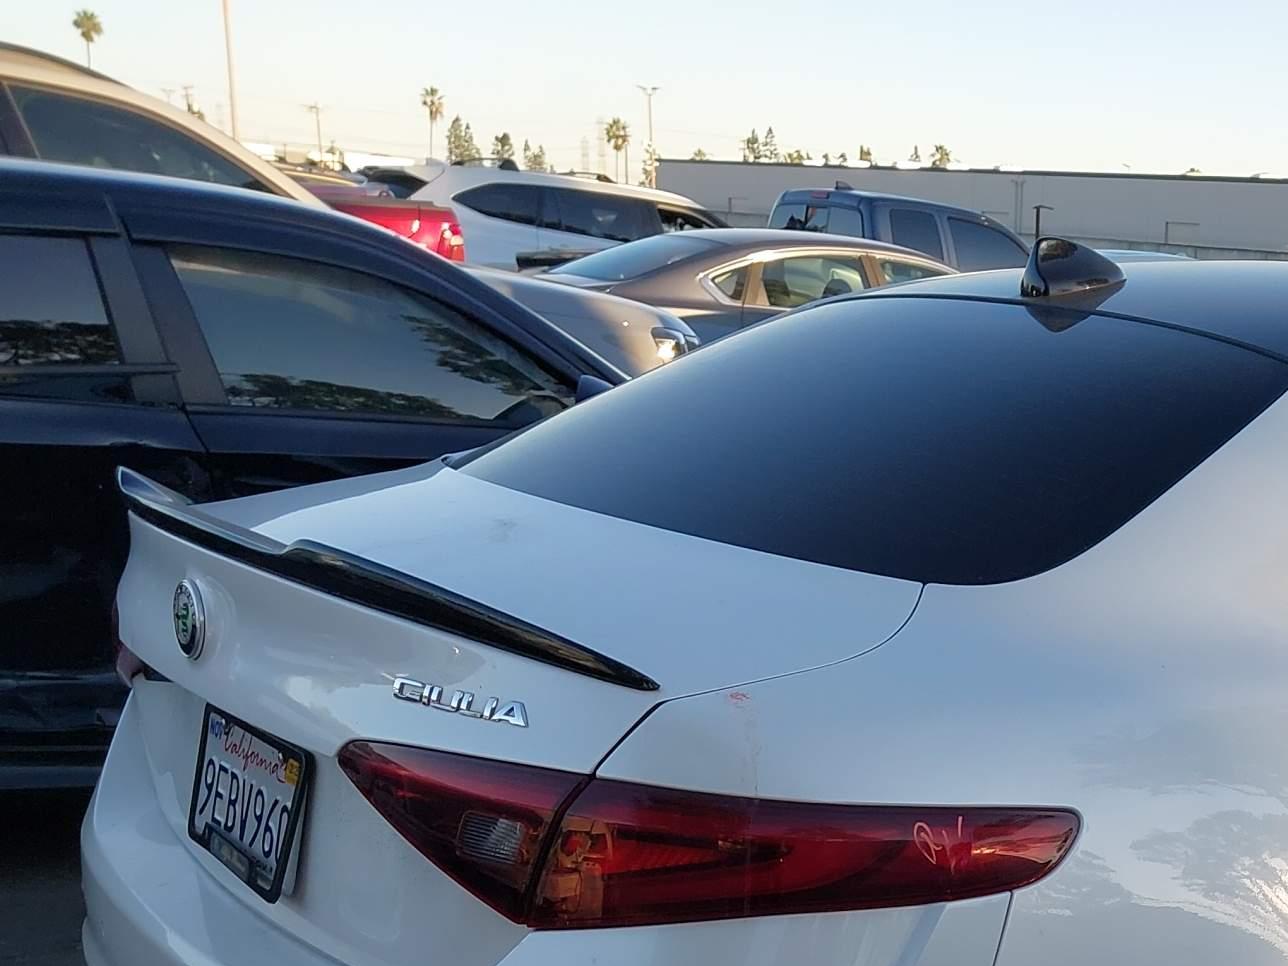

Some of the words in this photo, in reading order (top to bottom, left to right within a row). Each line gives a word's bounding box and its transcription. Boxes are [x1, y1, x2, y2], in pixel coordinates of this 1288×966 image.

[392, 677, 530, 729] GIULIA
[224, 724, 288, 783] California
[198, 757, 291, 863] 9EBV960
